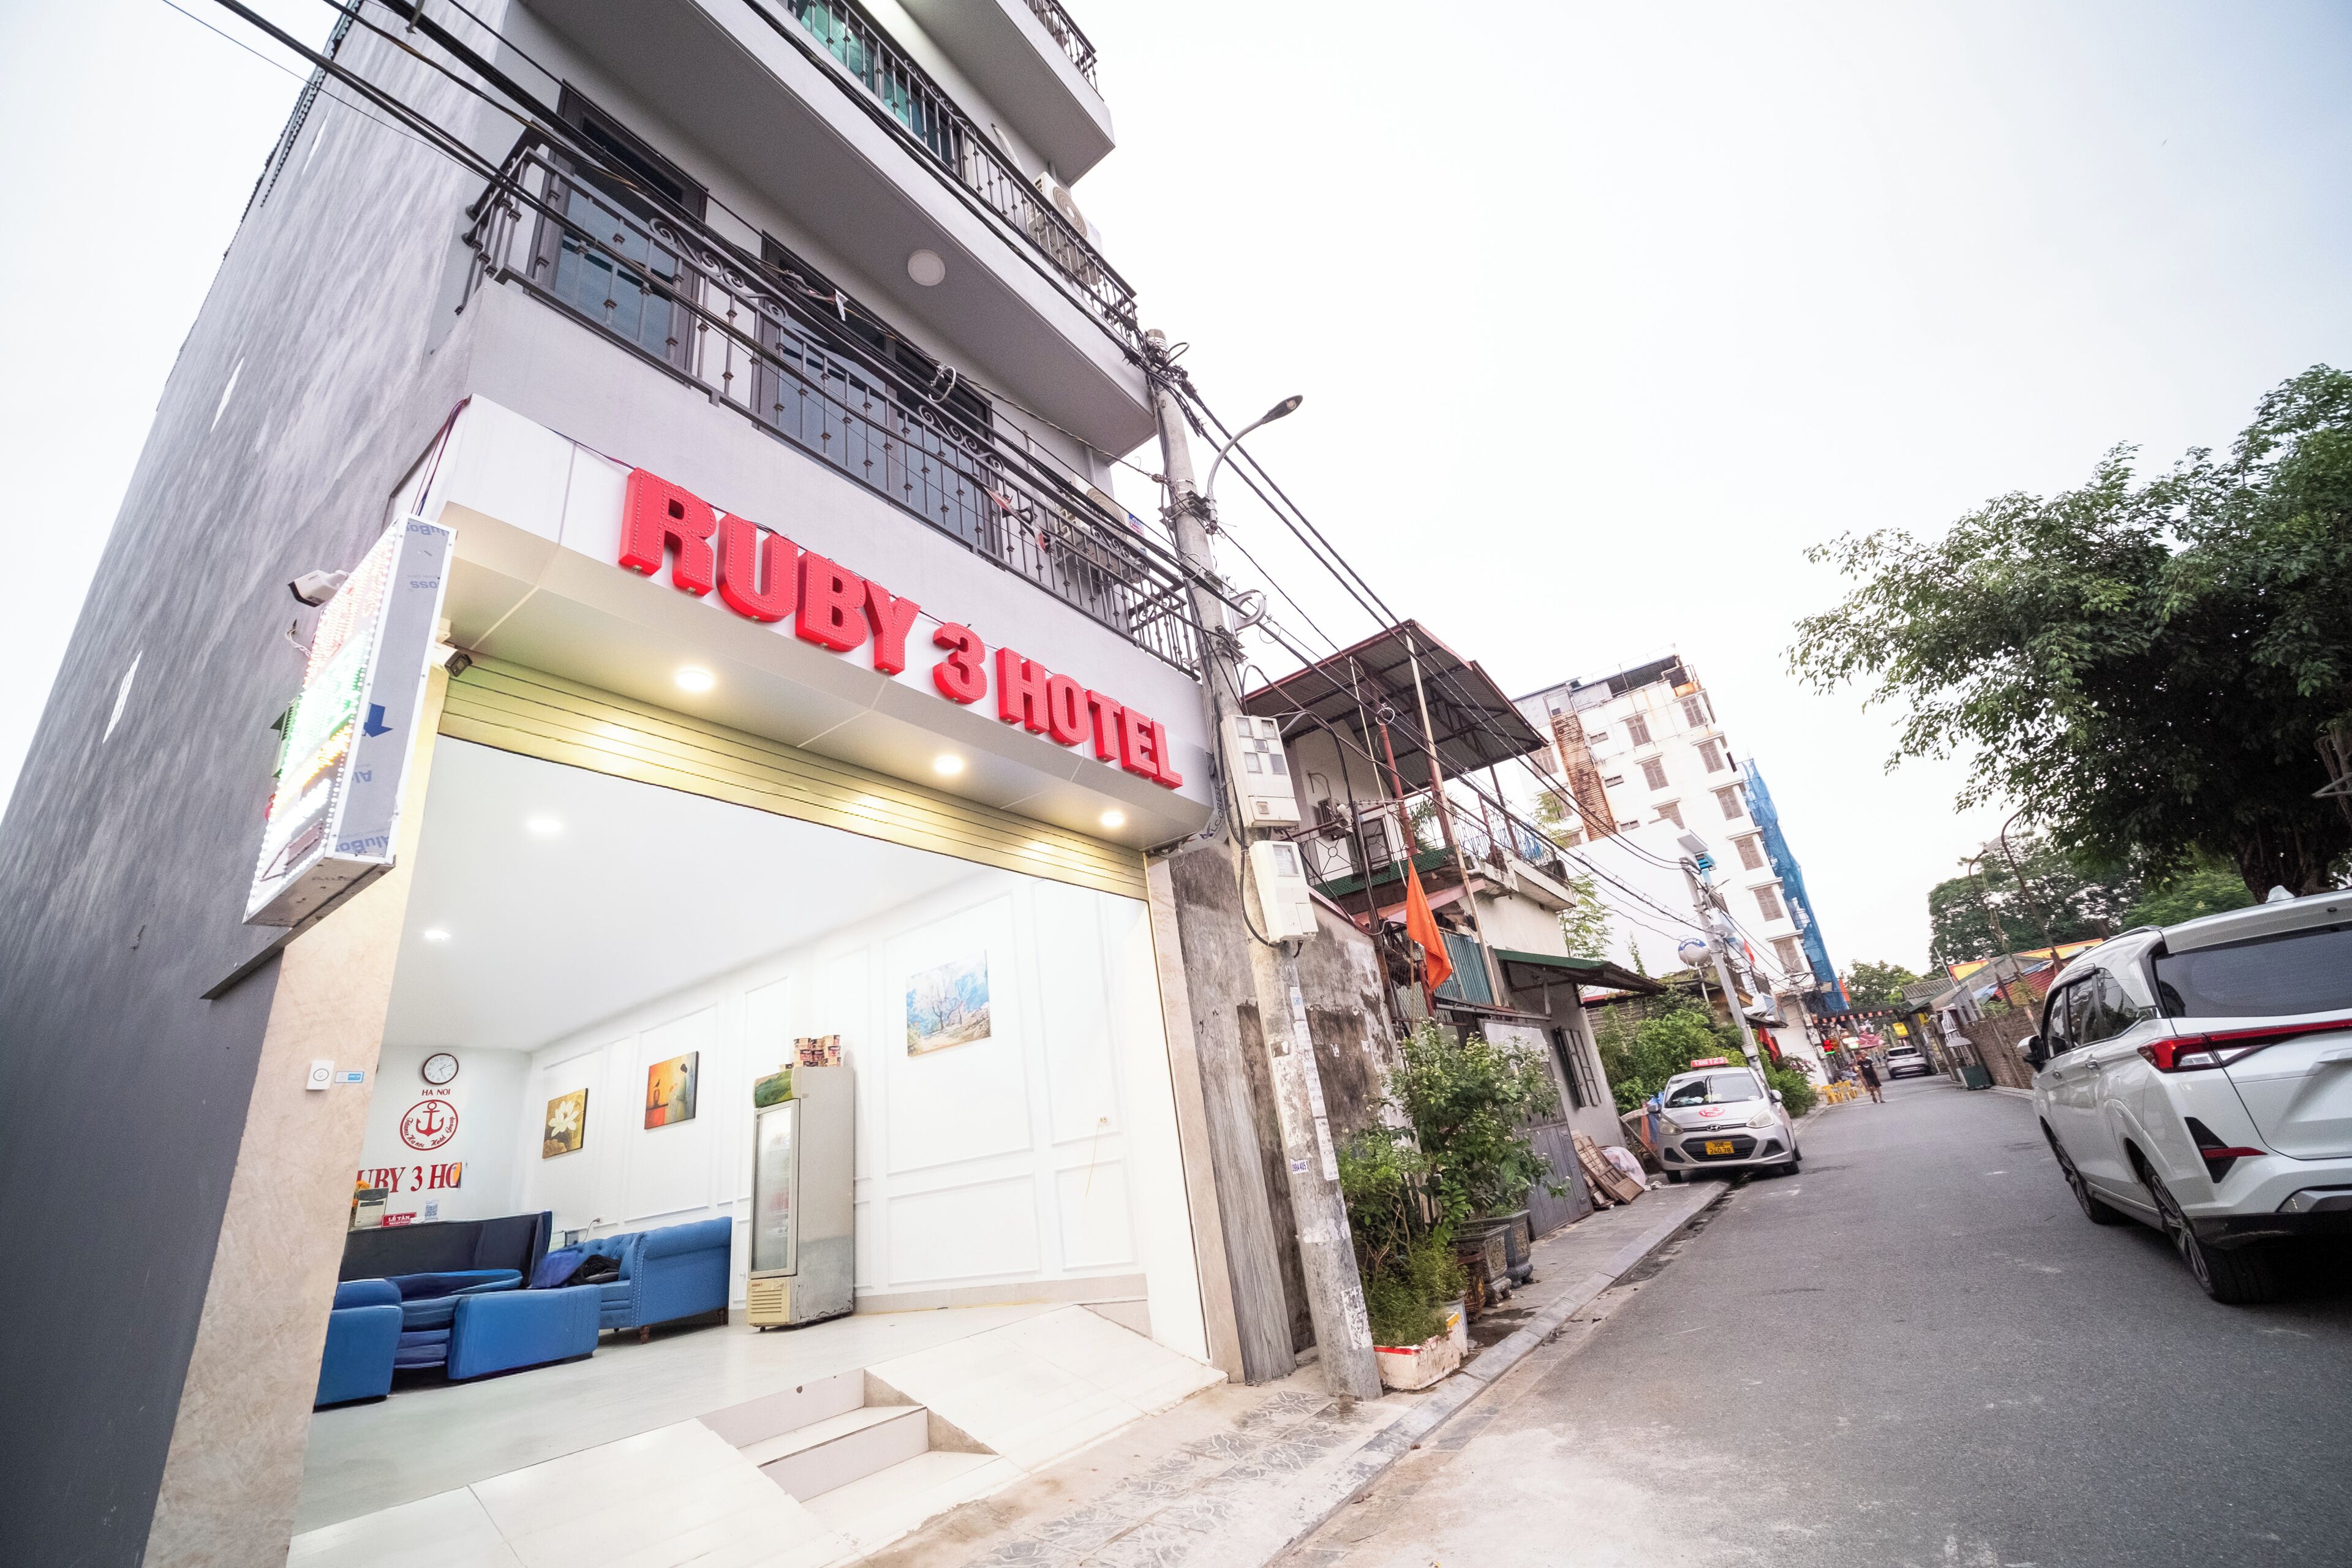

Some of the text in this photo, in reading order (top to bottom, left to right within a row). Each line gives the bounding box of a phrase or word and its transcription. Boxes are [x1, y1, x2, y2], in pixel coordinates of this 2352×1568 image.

[618, 466, 1184, 790] RUBY 3 HOTEL
[445, 1117, 456, 1133] Group
[410, 1166, 423, 1192] 3
